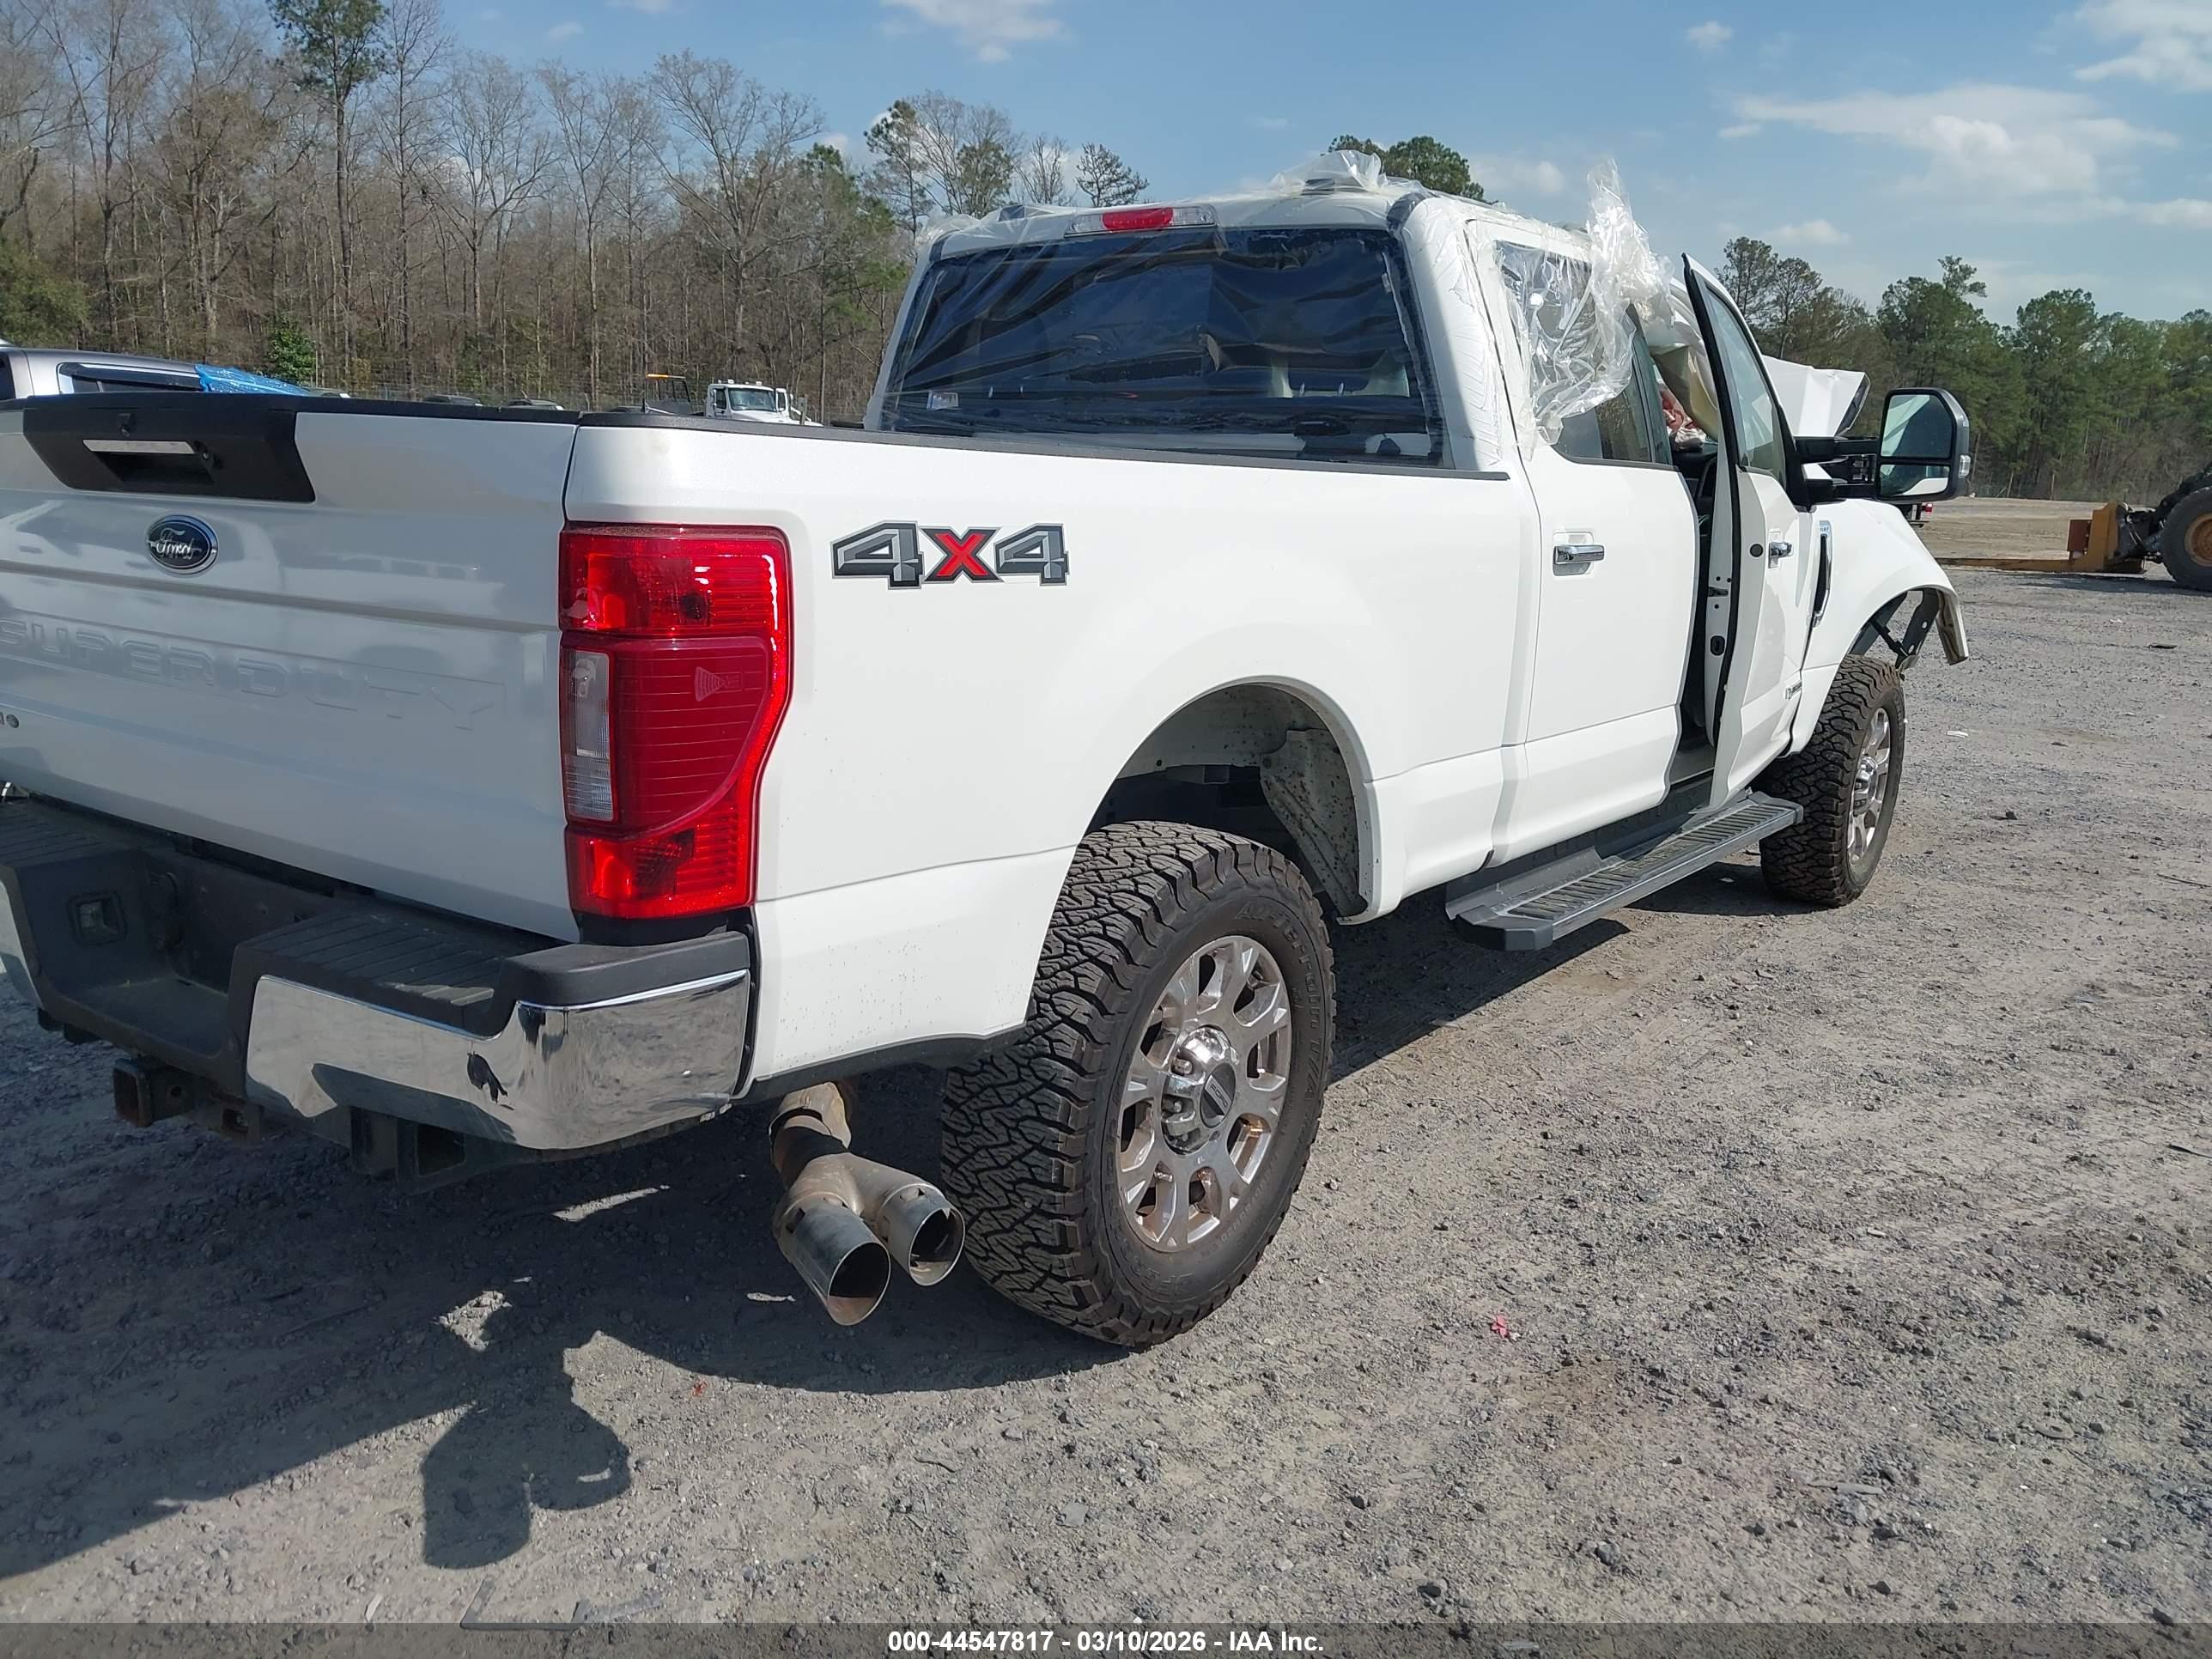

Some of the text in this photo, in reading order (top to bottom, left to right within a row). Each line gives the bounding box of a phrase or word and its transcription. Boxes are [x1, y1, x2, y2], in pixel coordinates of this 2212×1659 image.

[155, 527, 204, 561] Ford
[0, 617, 495, 732] SUPER DUTY
